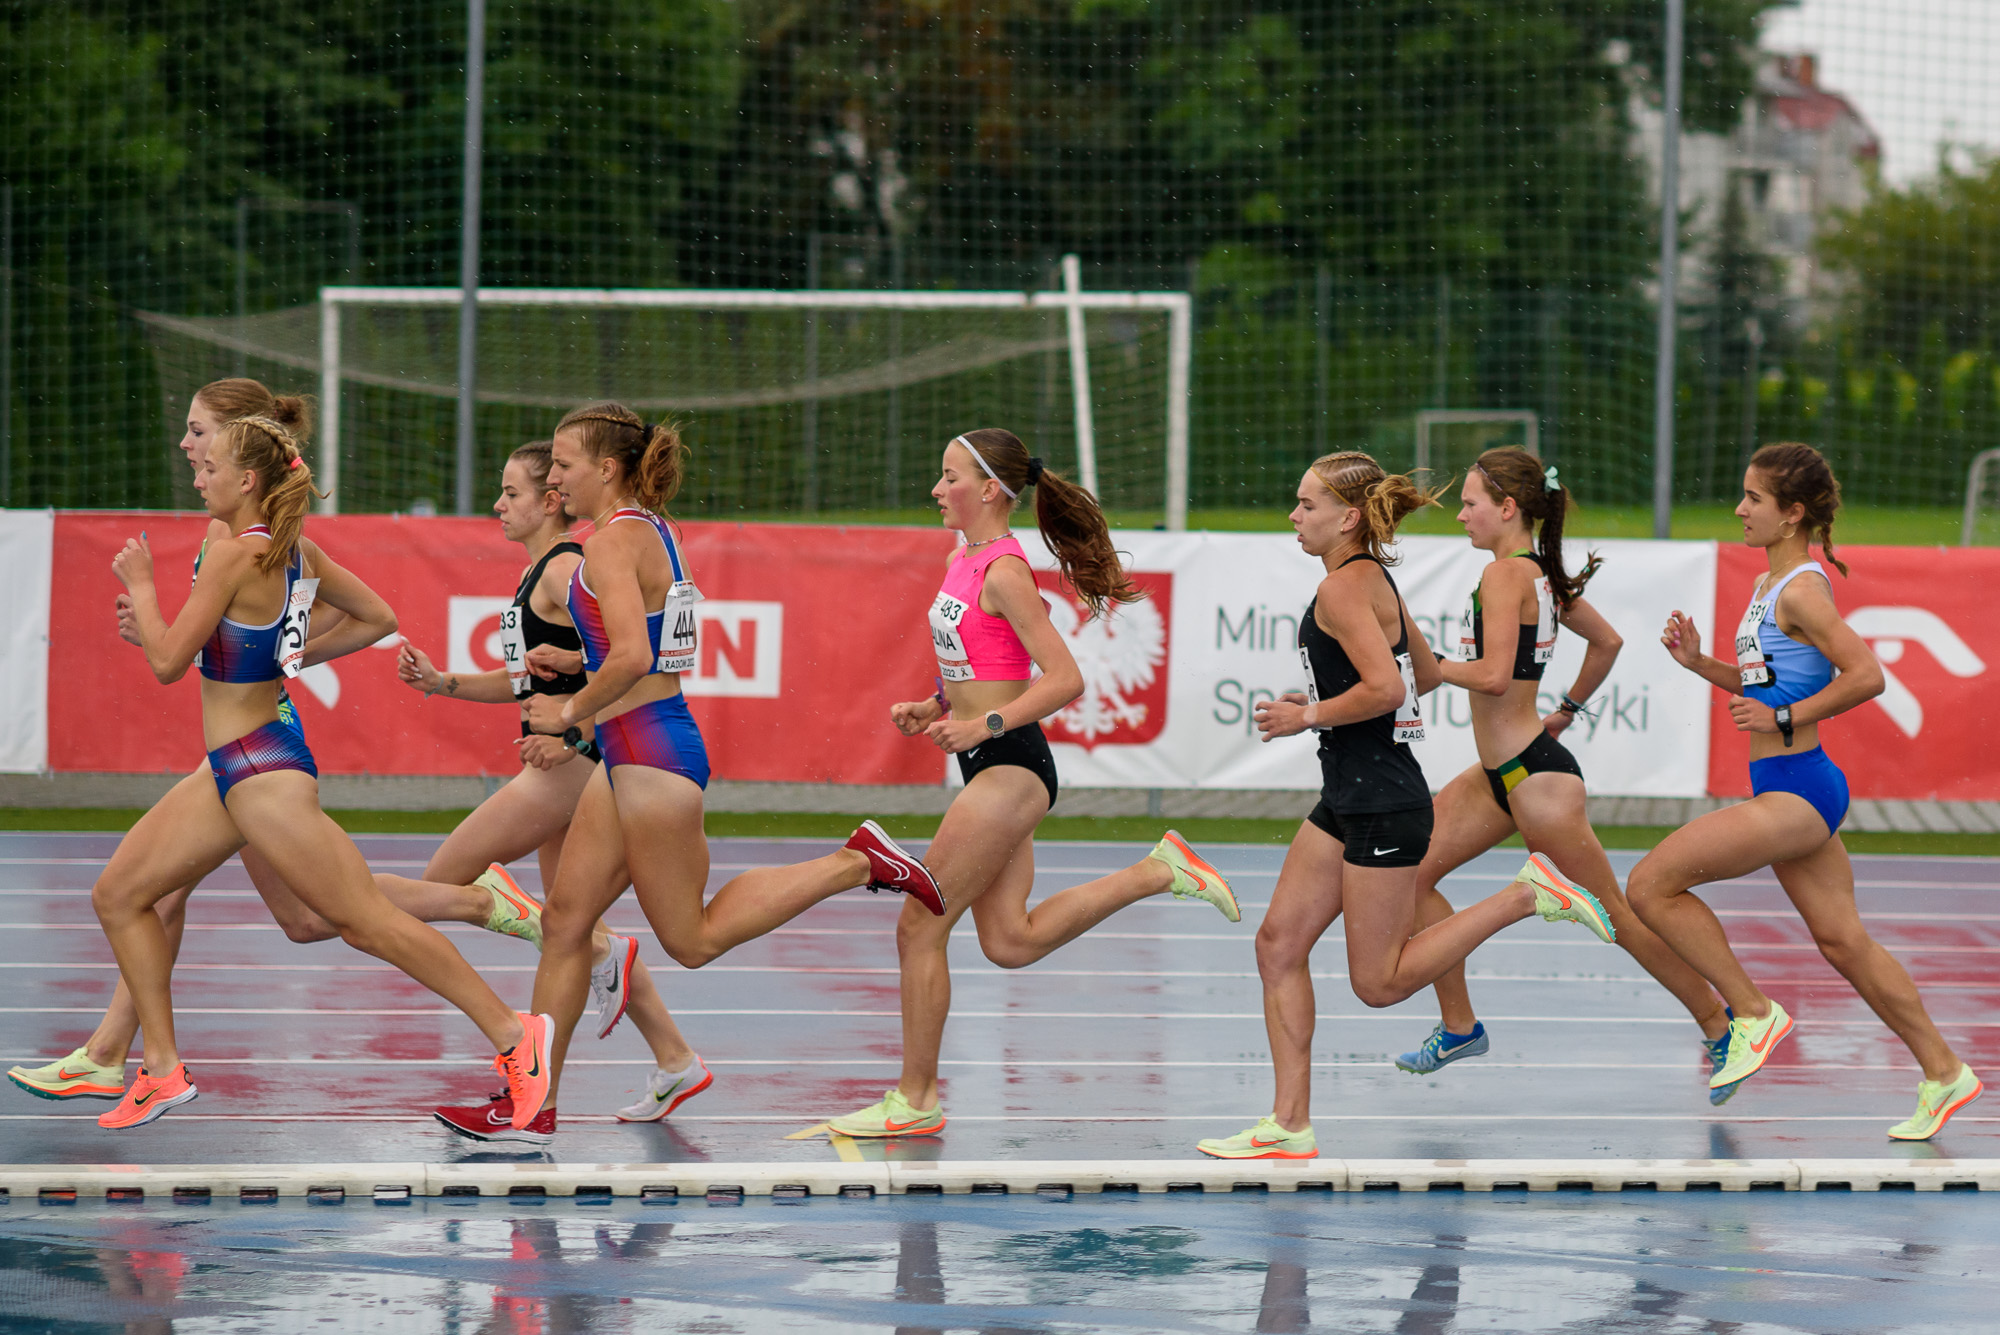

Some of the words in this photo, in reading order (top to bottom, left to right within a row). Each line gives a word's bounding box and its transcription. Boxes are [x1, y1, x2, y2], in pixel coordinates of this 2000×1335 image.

[940, 599, 962, 621] 483
[1748, 604, 1767, 622] 591
[673, 610, 694, 647] 444
